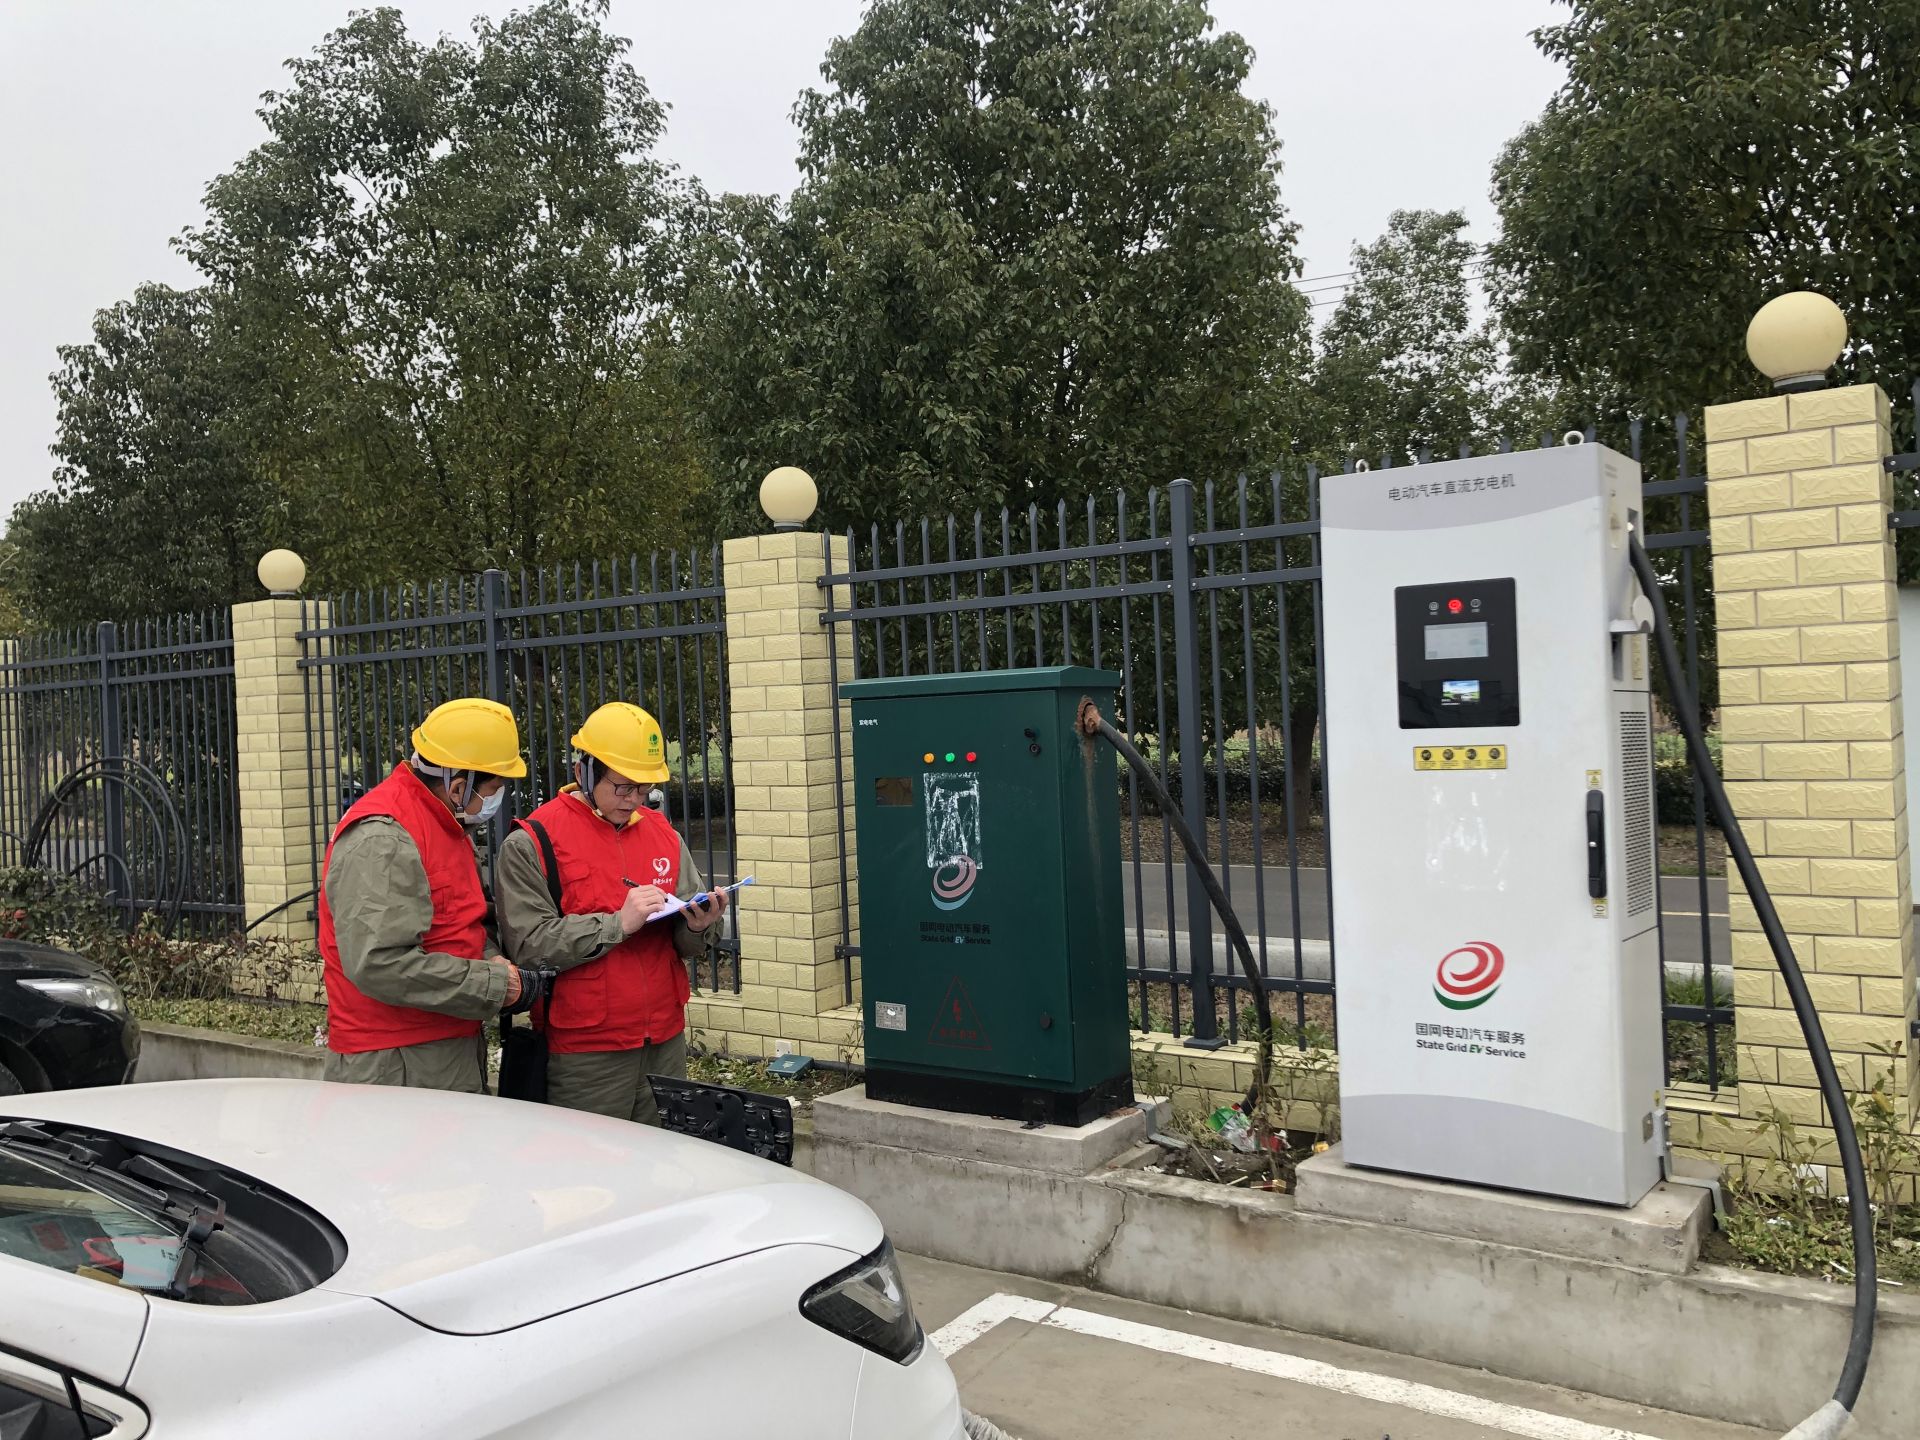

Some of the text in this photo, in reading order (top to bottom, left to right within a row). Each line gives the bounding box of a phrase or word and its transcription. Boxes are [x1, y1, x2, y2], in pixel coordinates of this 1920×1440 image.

[1388, 473, 1516, 501] 电动汽车直流充电机
[920, 934, 991, 945] State Grid EV Service
[1415, 1022, 1526, 1045] 国网电动汽车服务
[1416, 1039, 1526, 1059] State Grid EV Service
